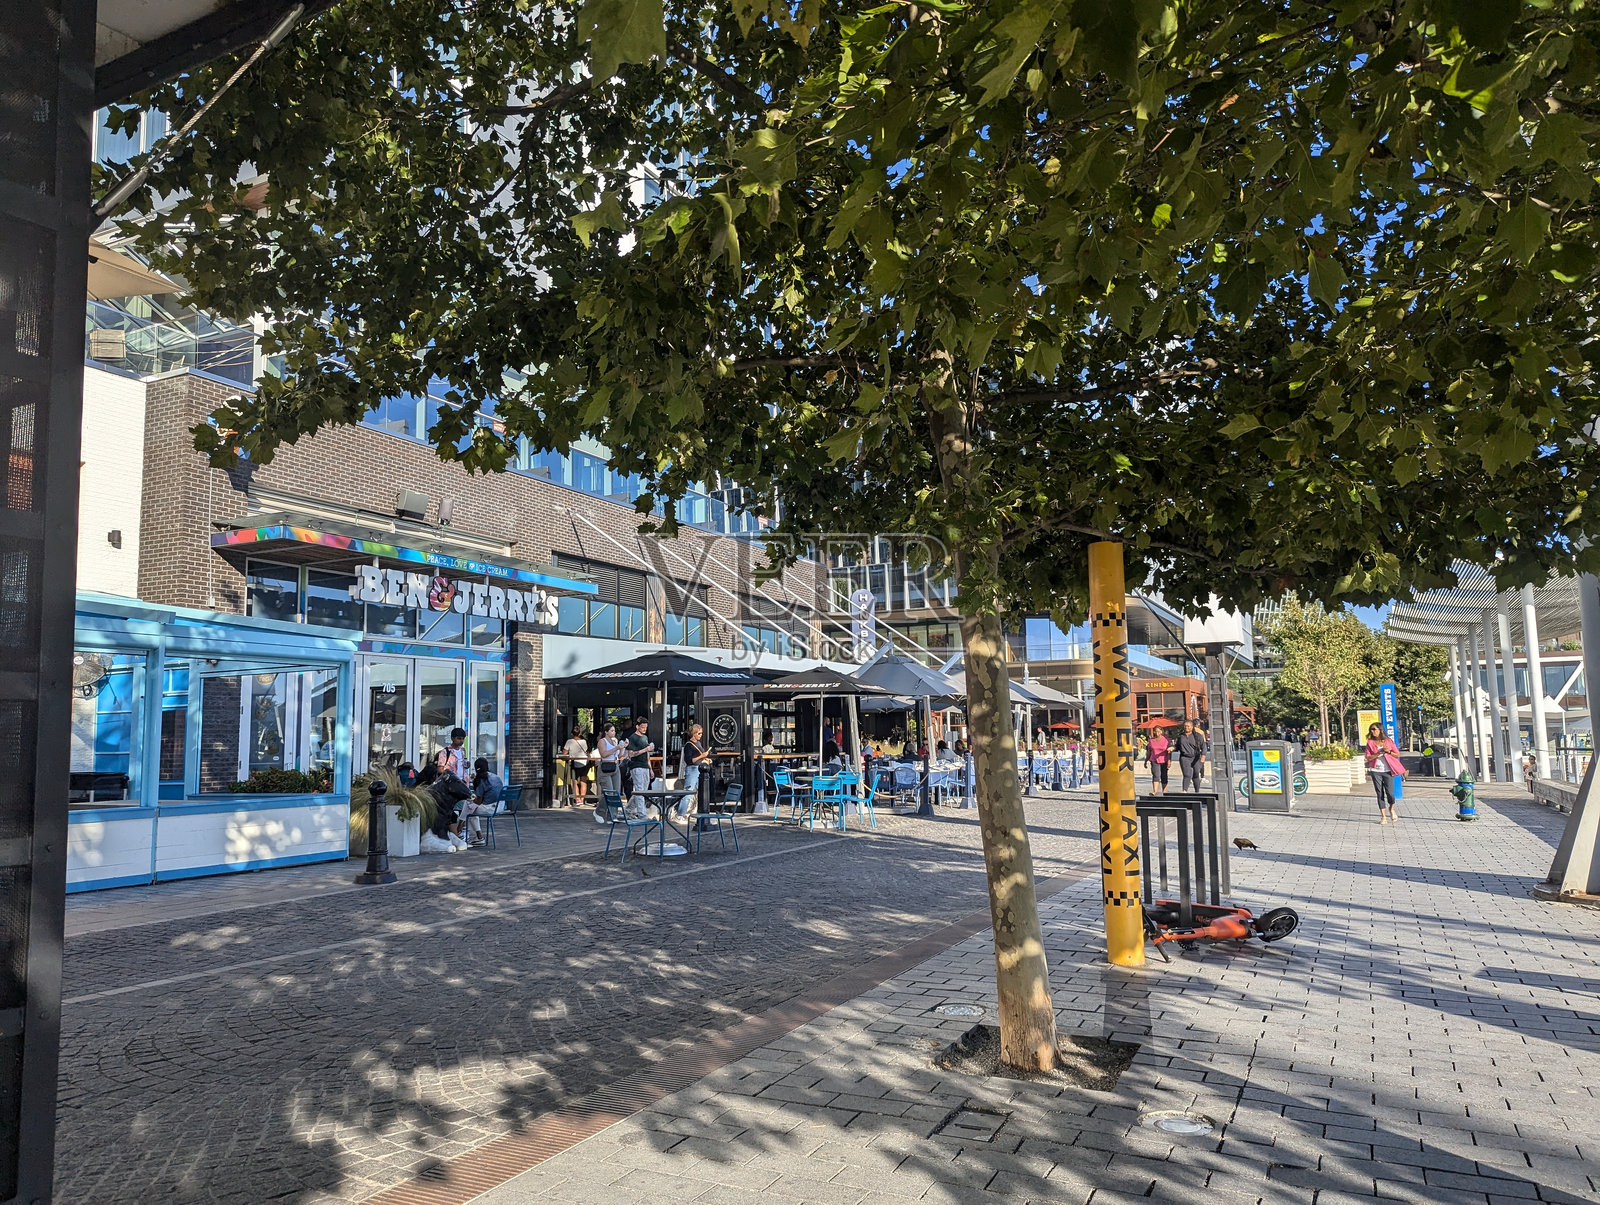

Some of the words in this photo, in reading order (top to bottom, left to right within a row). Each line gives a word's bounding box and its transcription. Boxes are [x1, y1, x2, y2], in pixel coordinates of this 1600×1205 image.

[426, 554, 449, 568] PEACE,
[450, 559, 468, 570] LOVE
[476, 563, 486, 573] ICE
[487, 566, 508, 577] CREAM
[355, 564, 430, 609] BEN
[429, 576, 455, 612] &
[452, 580, 560, 627] JERRY'S
[382, 682, 396, 693] 705
[1383, 688, 1393, 723] EVENTS
